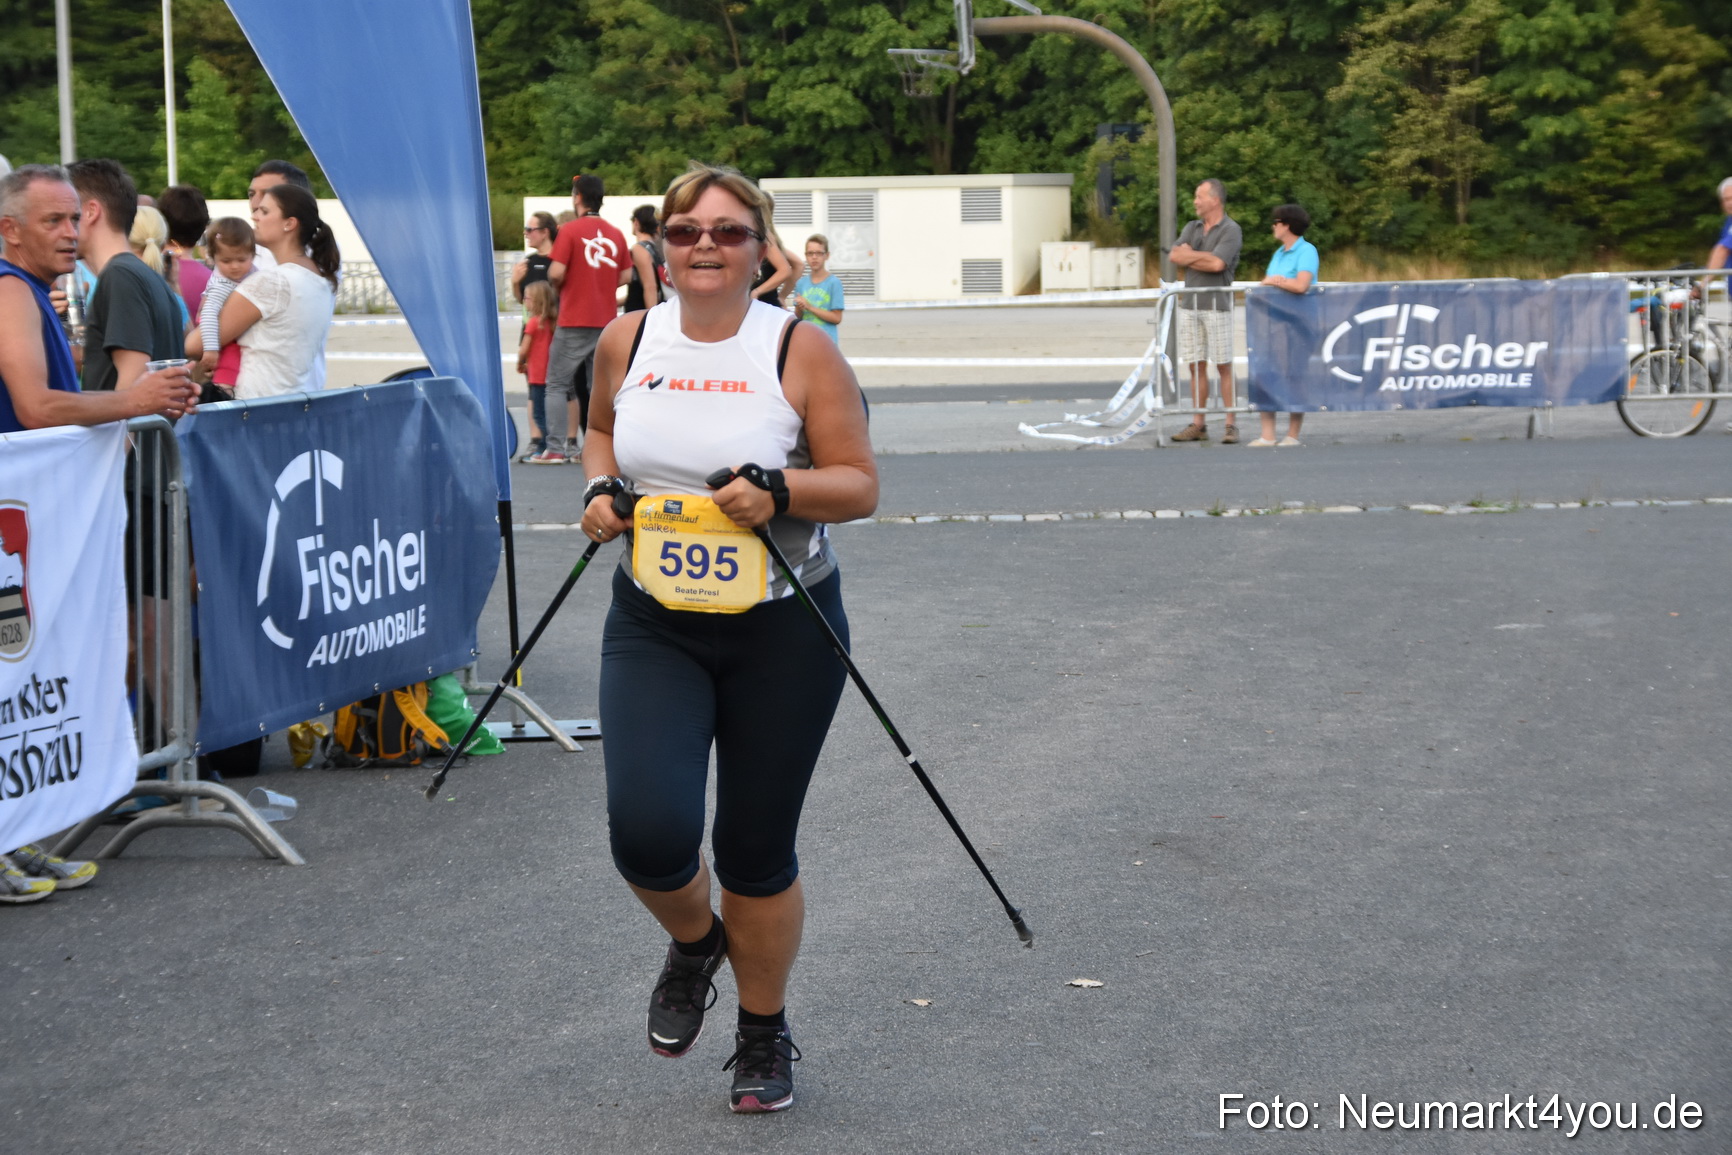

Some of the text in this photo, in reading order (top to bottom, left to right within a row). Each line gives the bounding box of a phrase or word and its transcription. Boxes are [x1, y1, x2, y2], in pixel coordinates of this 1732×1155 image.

[1362, 334, 1549, 372] Fischer
[669, 378, 755, 394] KLEBL
[1378, 373, 1533, 392] AUTOMOBILE
[653, 510, 699, 524] firmenlauf
[641, 523, 677, 534] walken
[659, 540, 739, 582] 595
[675, 586, 719, 597] Beate Presl
[0, 622, 23, 646] 628
[306, 604, 427, 669] AUTOMOBILE
